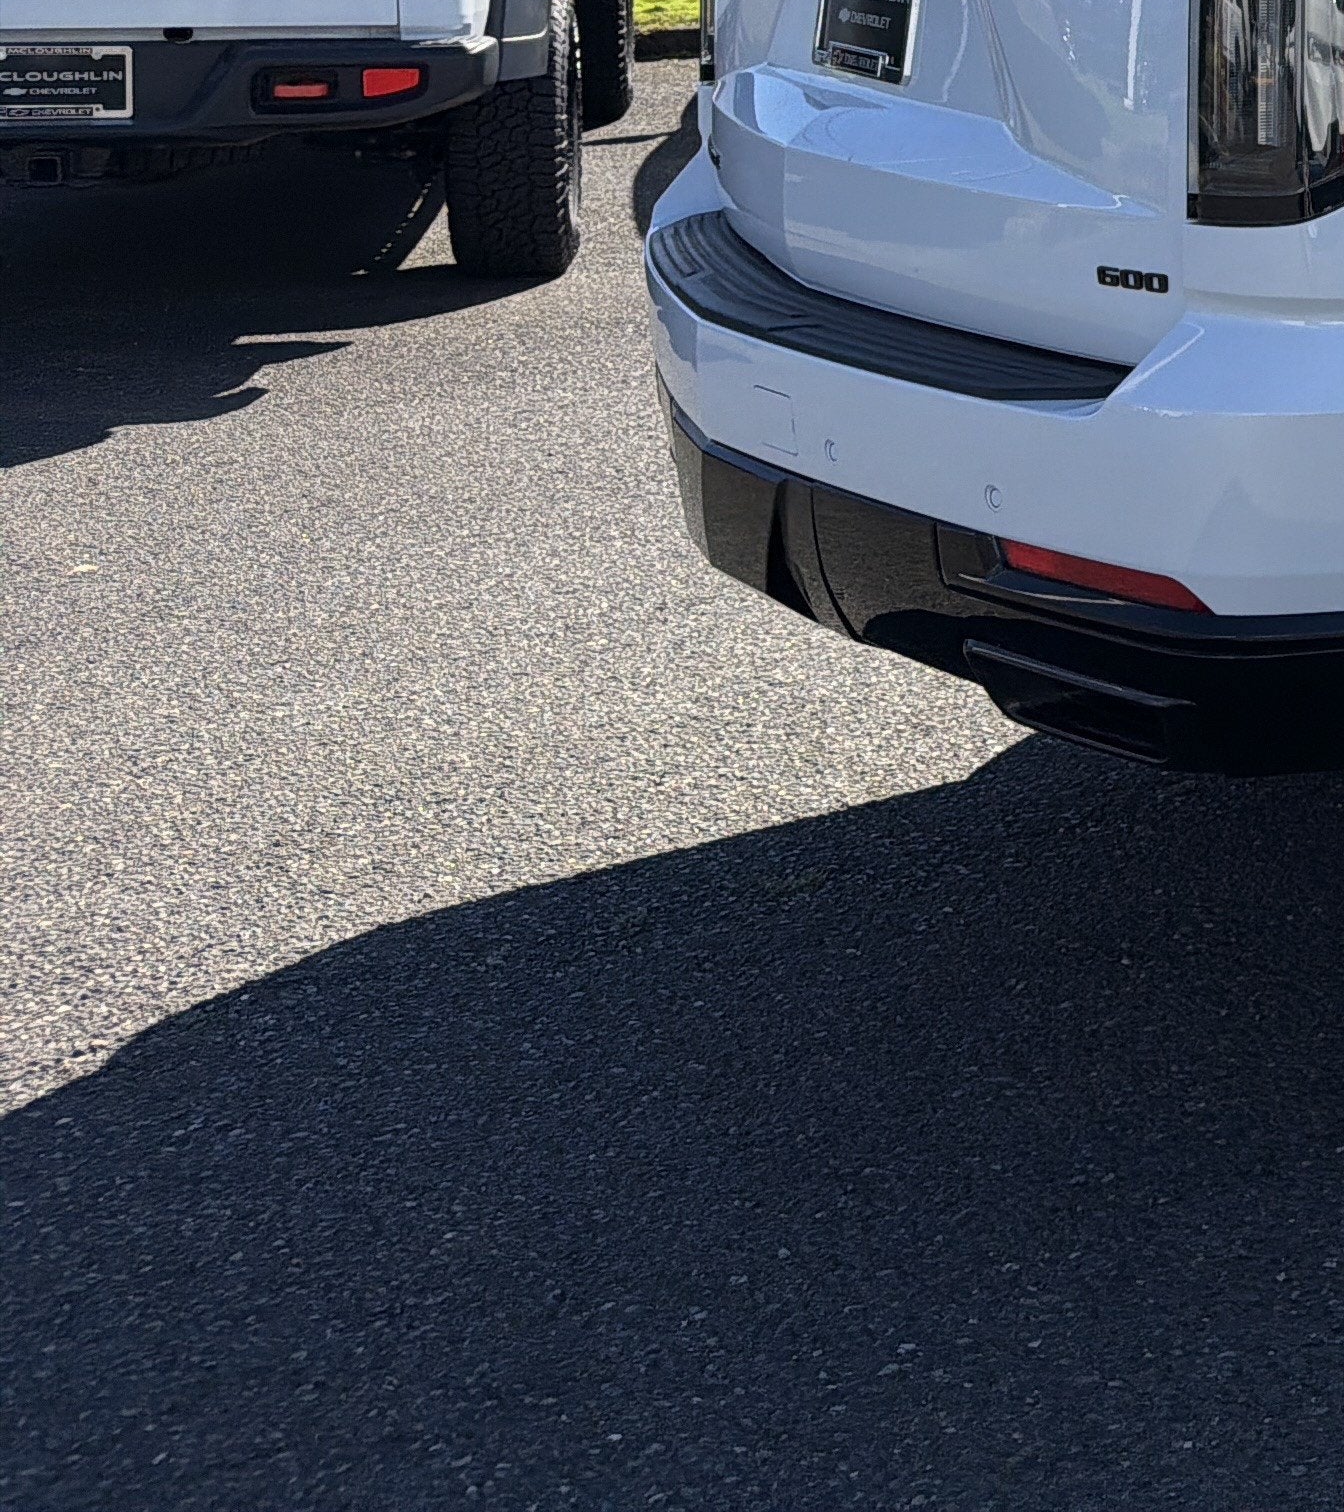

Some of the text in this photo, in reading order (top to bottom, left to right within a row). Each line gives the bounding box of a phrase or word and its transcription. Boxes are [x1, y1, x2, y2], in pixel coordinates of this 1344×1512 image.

[850, 9, 892, 30] CHEVROLET
[29, 87, 98, 95] CHEVROLET
[1096, 265, 1169, 294] 600
